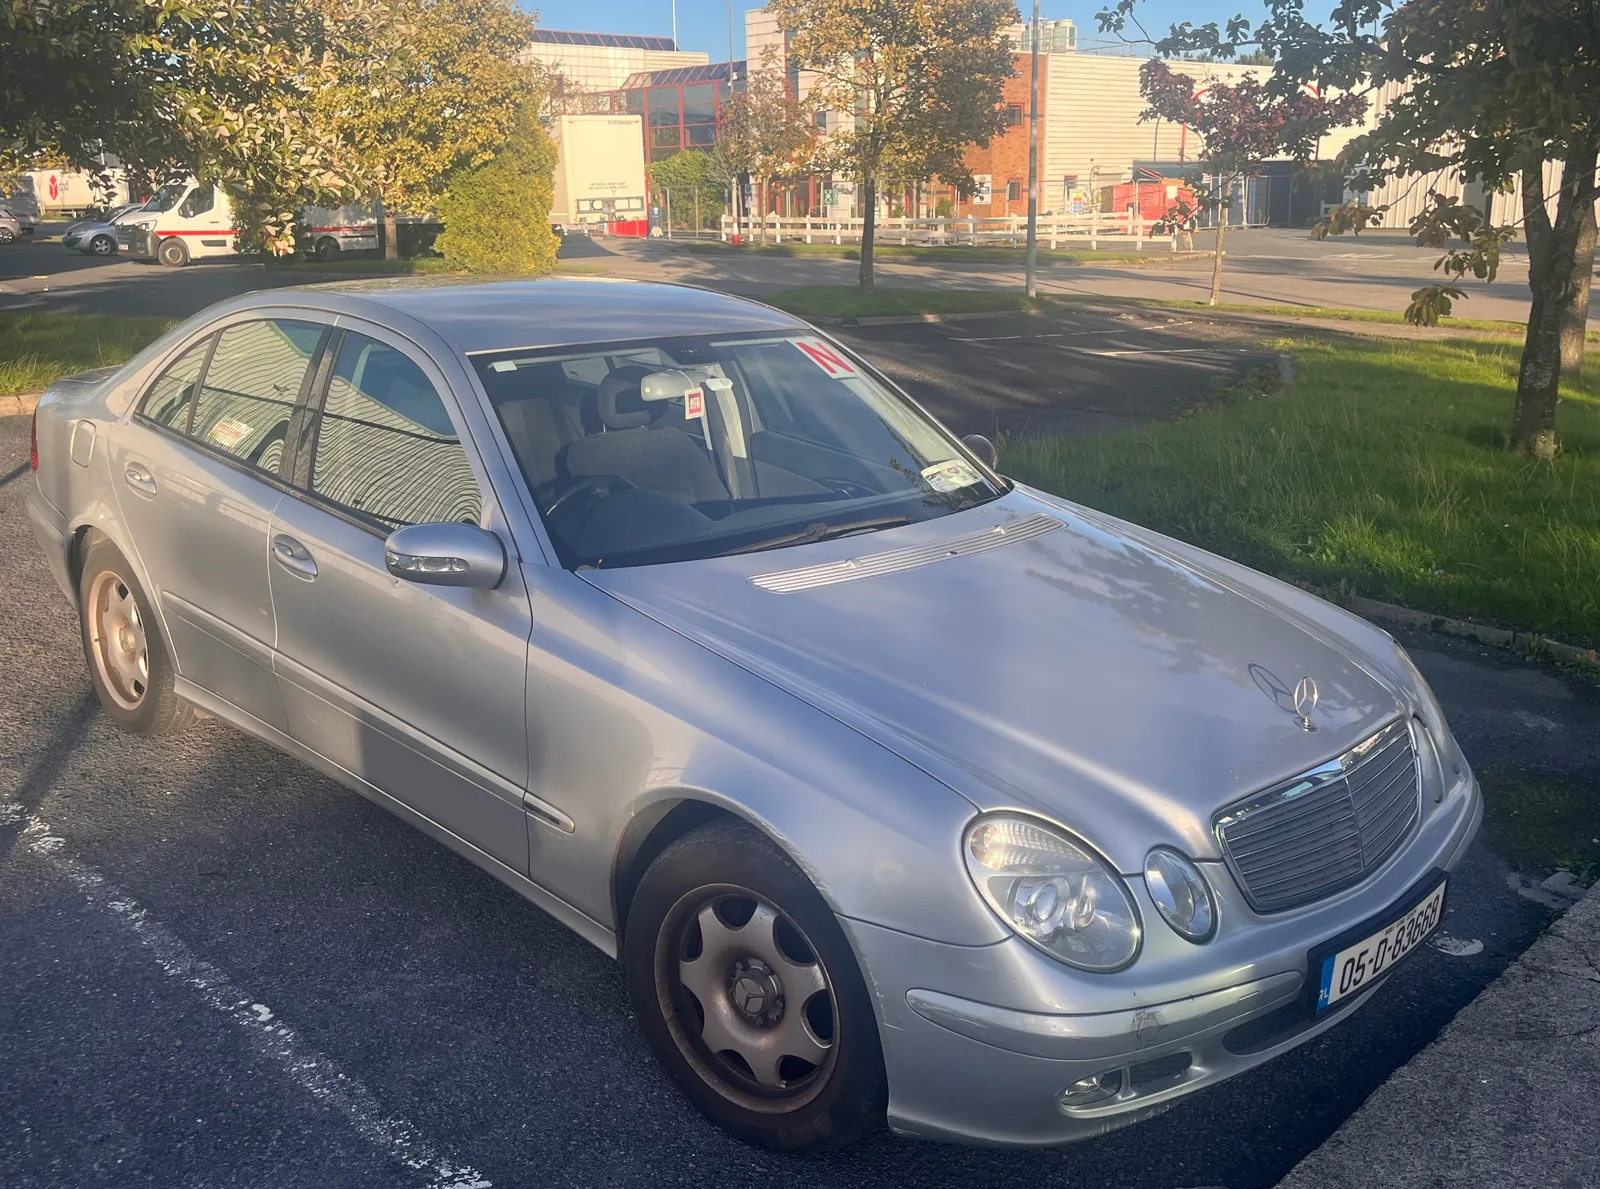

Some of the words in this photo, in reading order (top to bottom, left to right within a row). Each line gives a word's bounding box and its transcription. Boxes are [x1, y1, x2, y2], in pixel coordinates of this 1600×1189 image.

[59, 179, 69, 193] dpd
[796, 342, 855, 373] N
[1339, 894, 1440, 995] 05-D-83668
